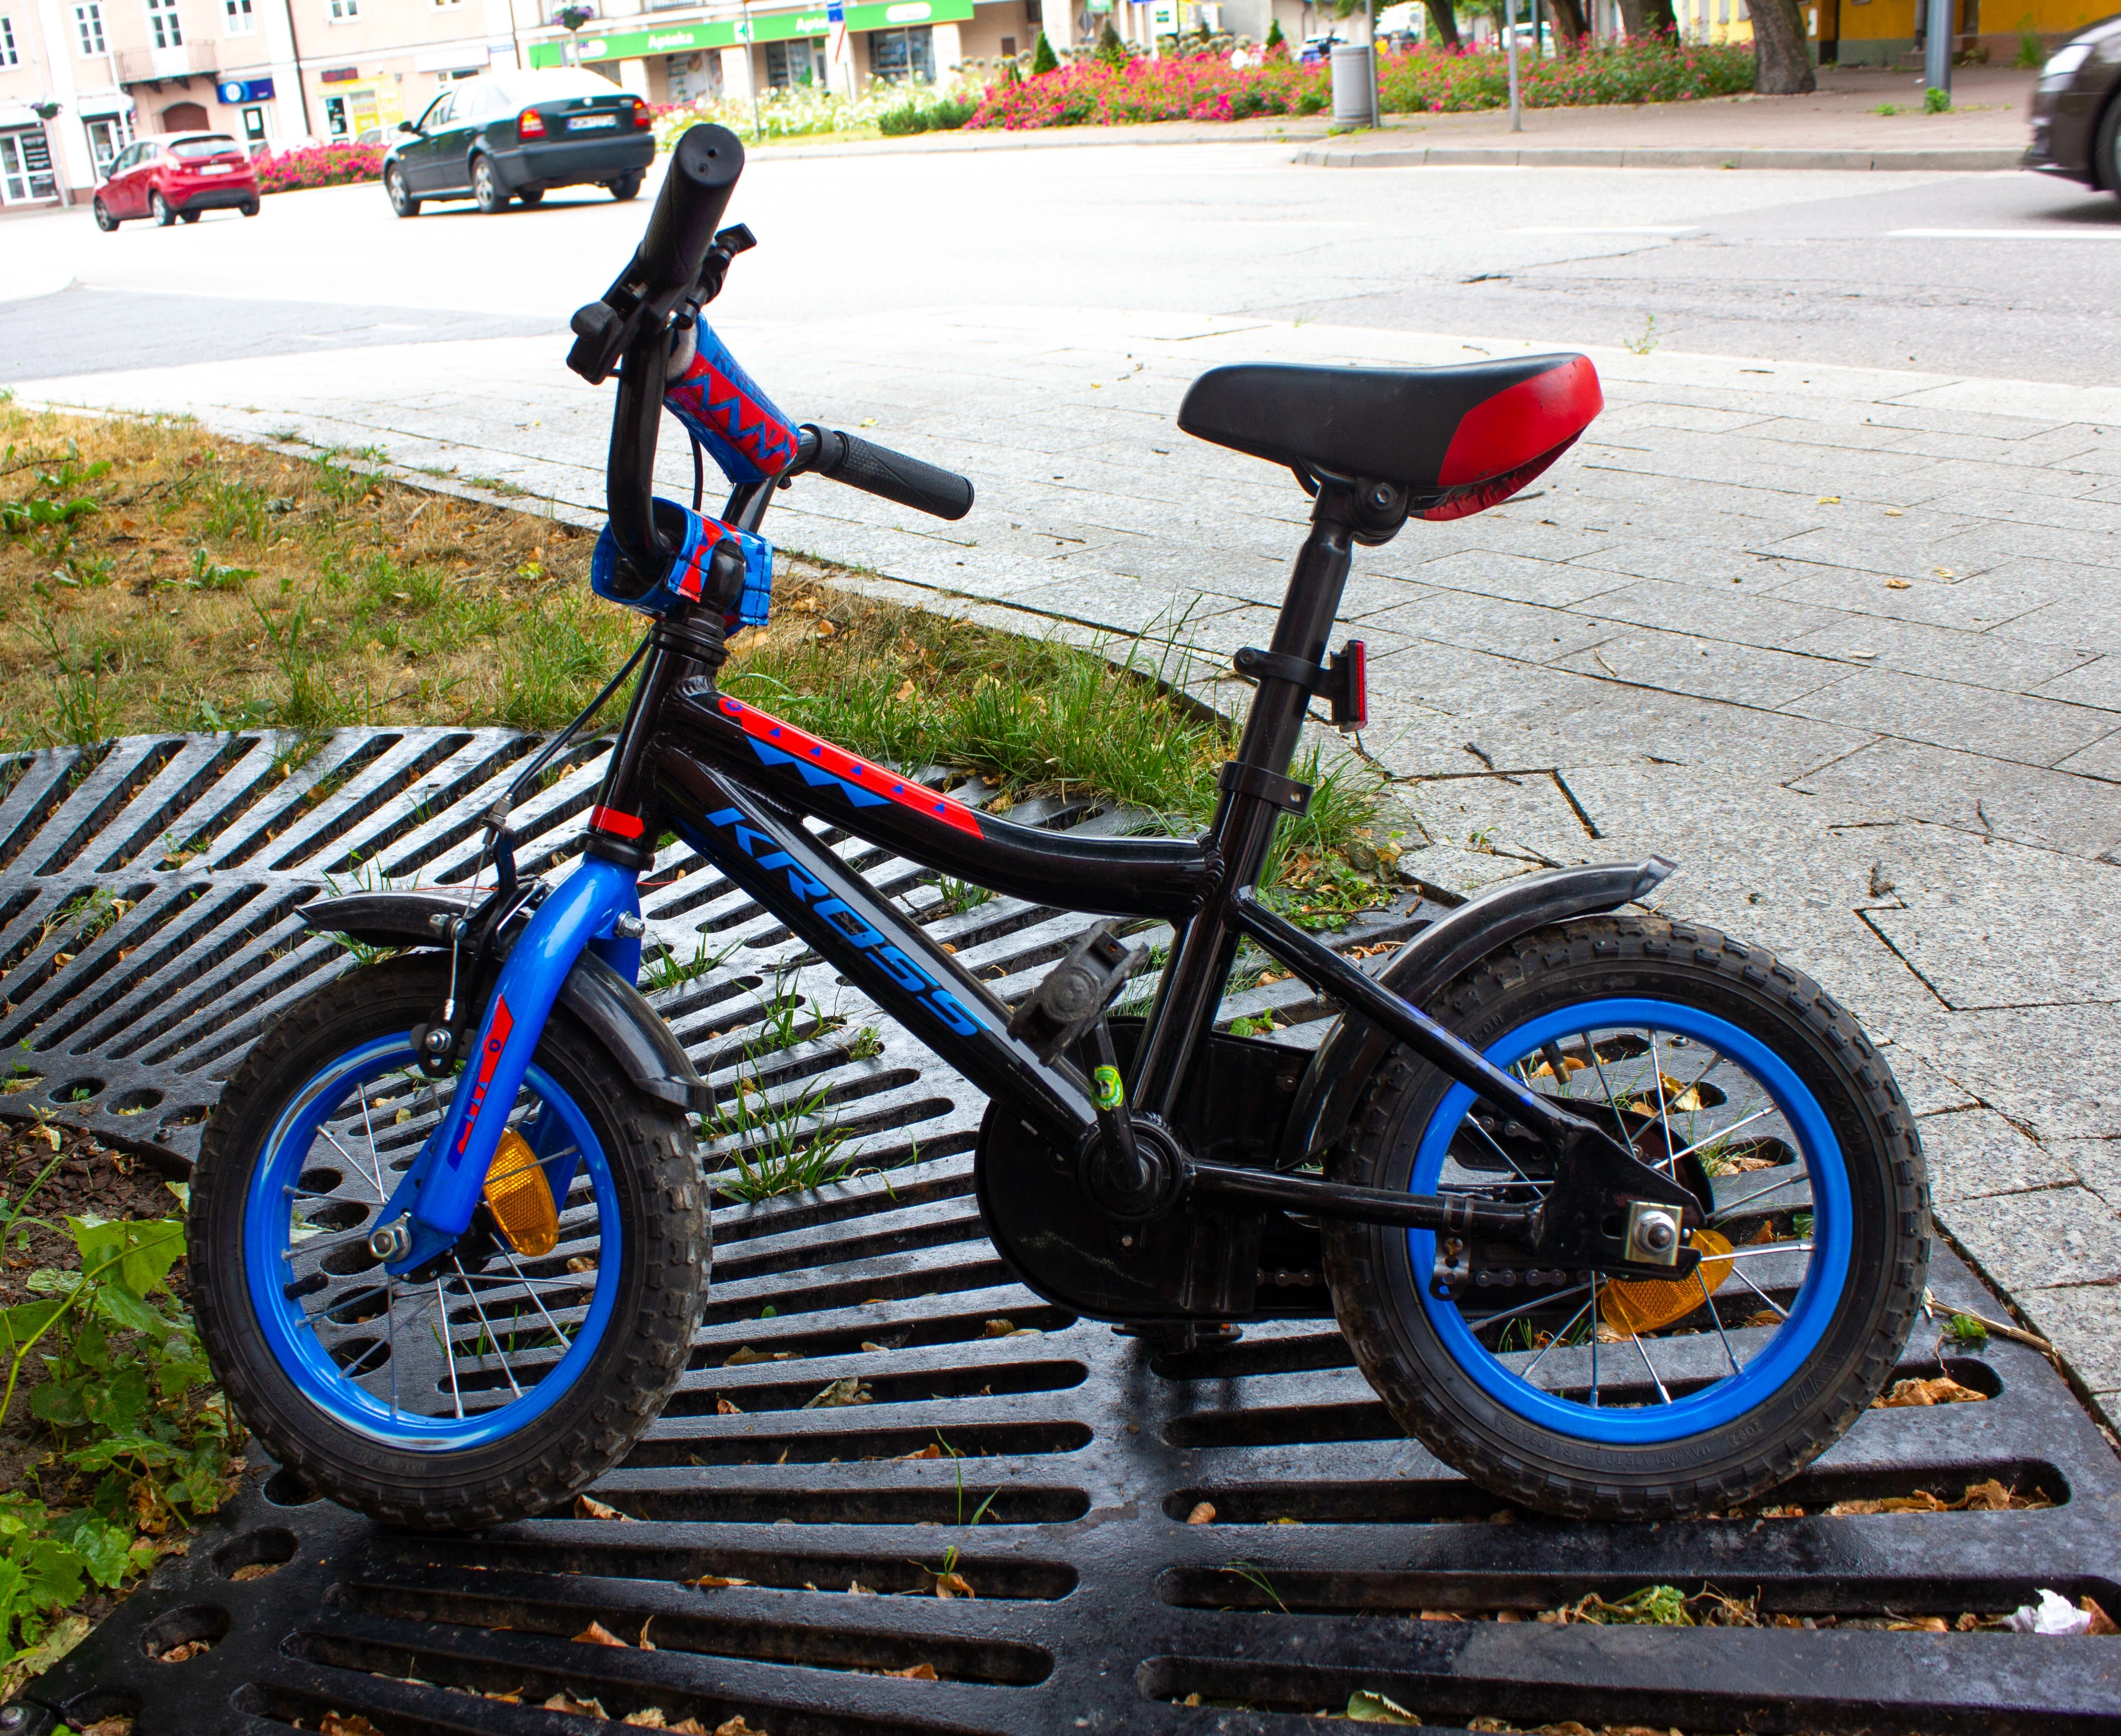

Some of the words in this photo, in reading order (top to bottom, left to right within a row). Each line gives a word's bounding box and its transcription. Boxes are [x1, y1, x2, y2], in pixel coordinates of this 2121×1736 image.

[648, 31, 694, 51] Apteka
[796, 17, 828, 34] Apte
[711, 349, 781, 421] KROSS
[705, 807, 992, 1036] KROSS
